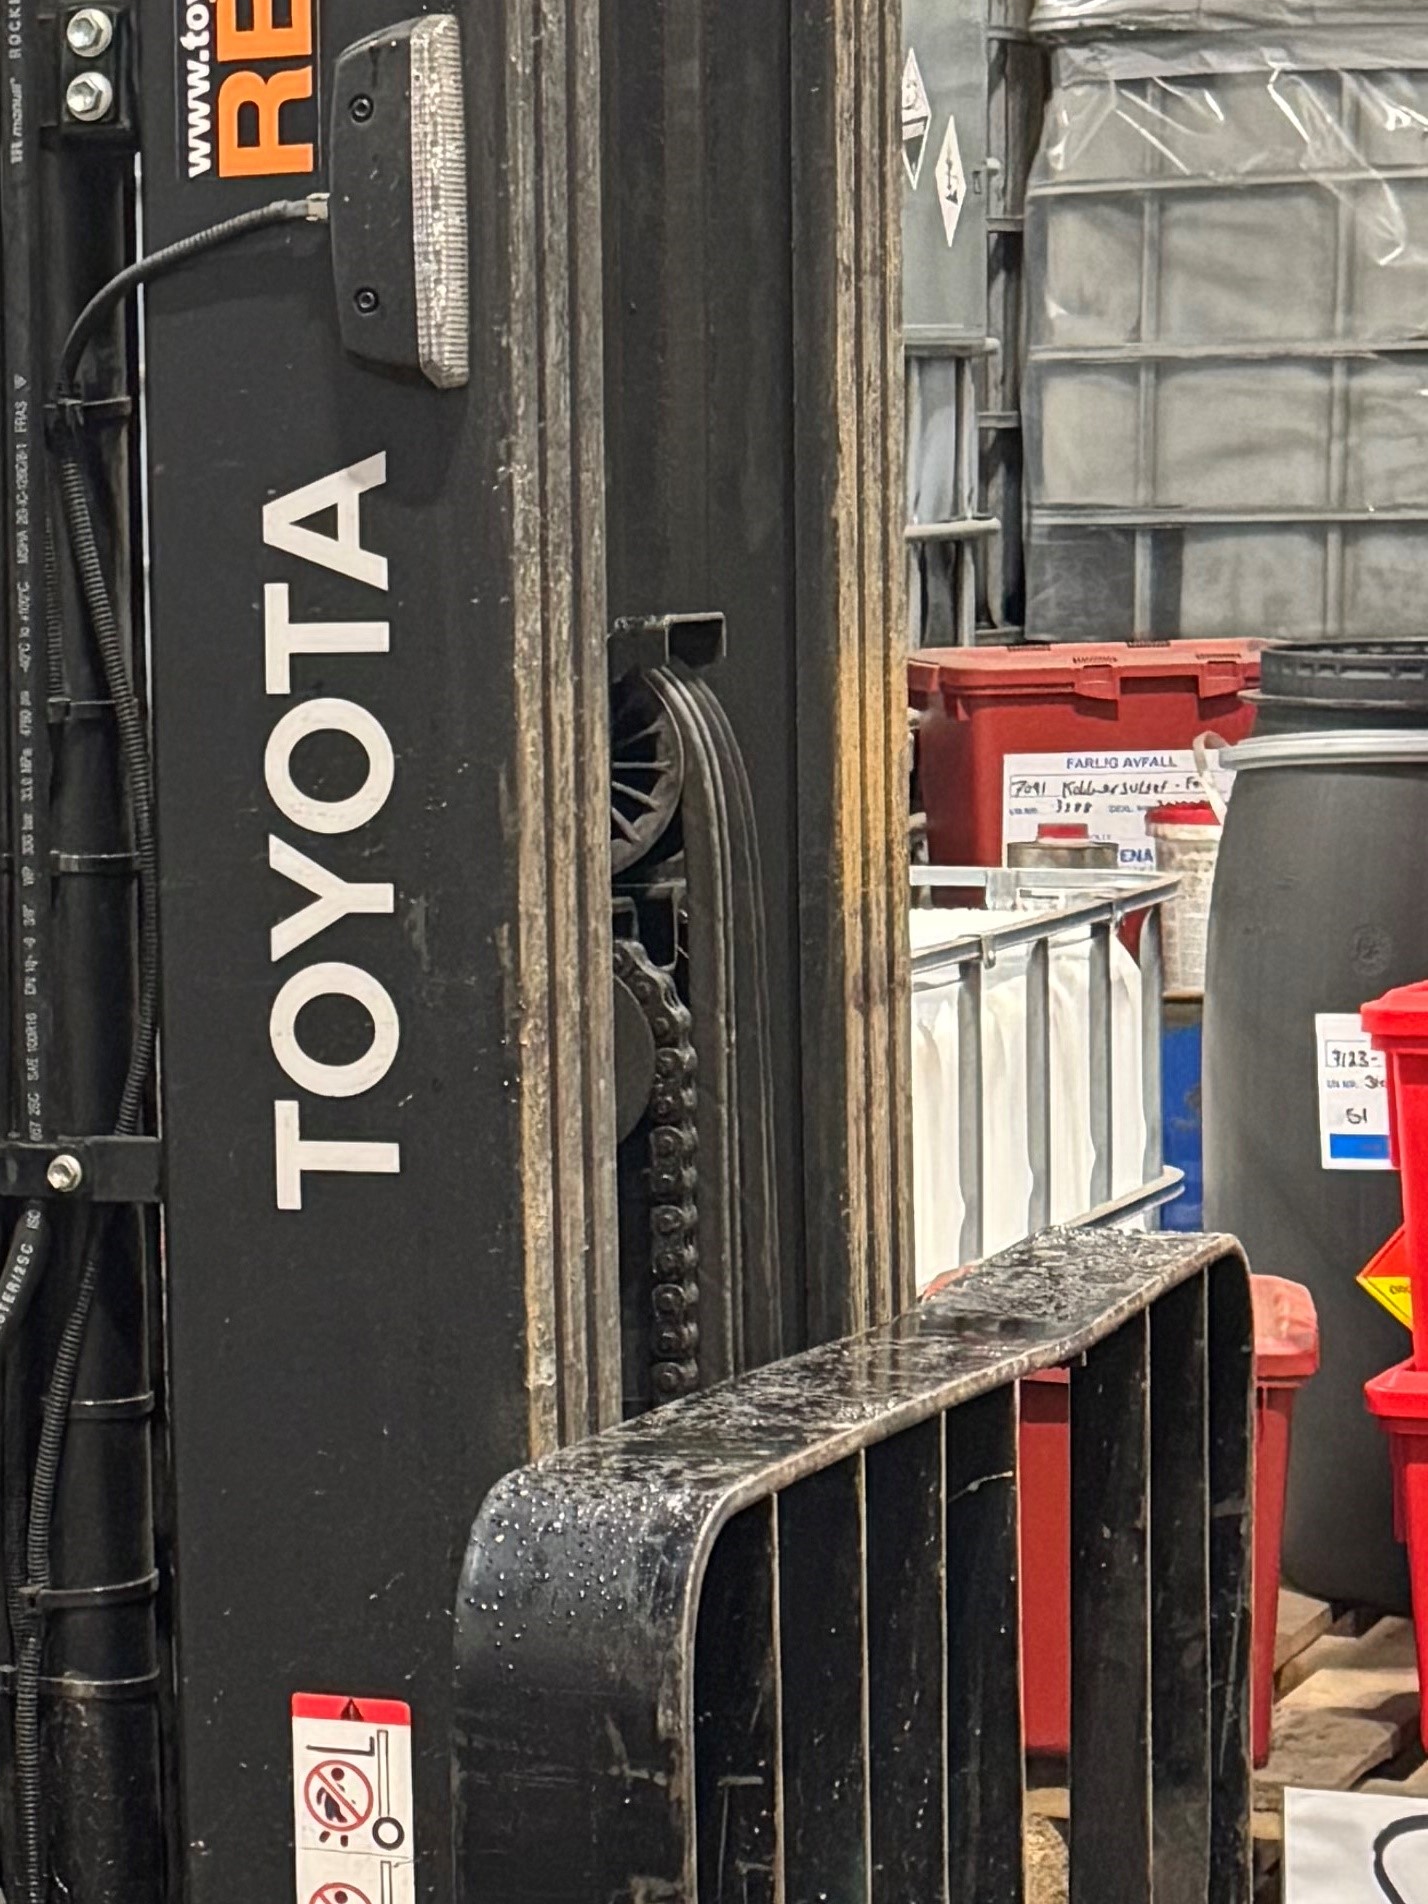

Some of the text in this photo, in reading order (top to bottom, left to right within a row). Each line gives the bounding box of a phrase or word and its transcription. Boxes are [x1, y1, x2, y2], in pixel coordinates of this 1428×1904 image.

[262, 450, 400, 1210] TOYOTA
[1065, 755, 1178, 769] FARLIG AVFALL
